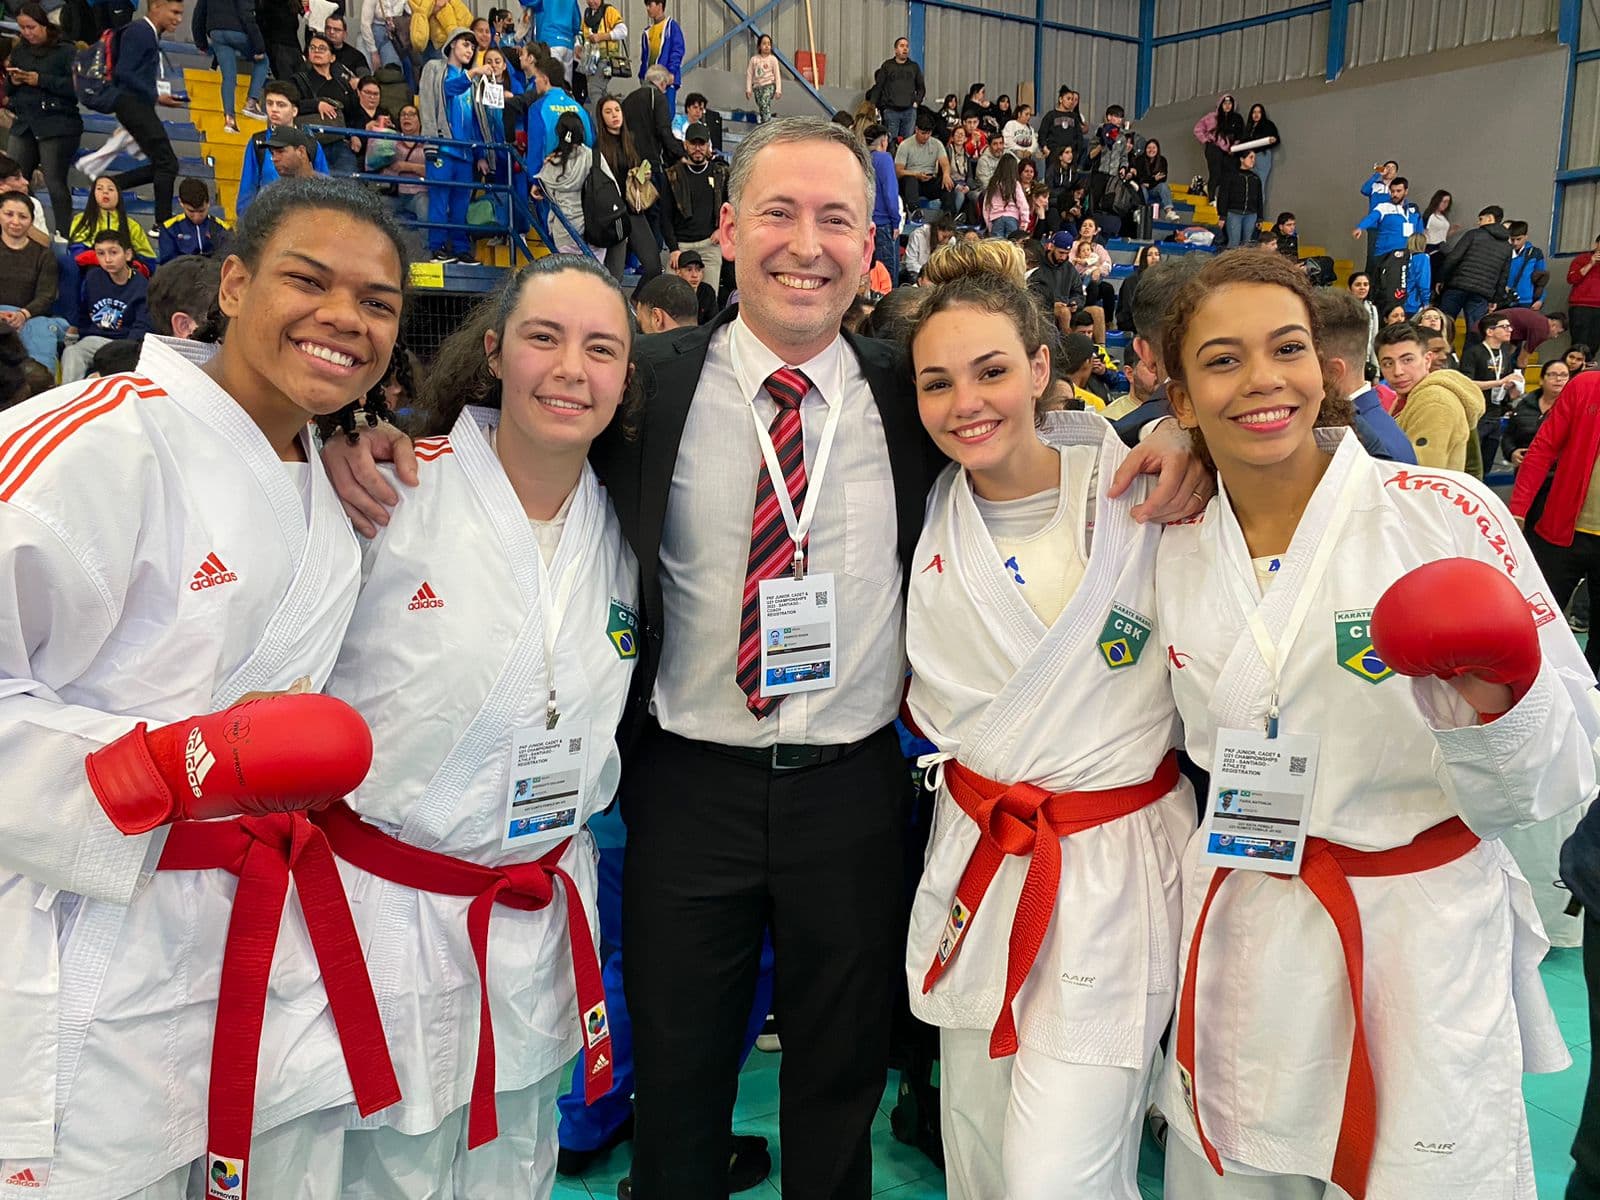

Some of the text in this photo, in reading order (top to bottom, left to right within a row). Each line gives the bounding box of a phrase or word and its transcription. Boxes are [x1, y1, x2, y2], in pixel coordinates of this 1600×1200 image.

[190, 572, 238, 591] adidas
[408, 599, 444, 611] adidas
[1114, 619, 1143, 640] CBK
[185, 726, 202, 798] adidas
[1235, 754, 1278, 762] CHAMPIONSHIPS
[6, 1178, 40, 1188] adidas
